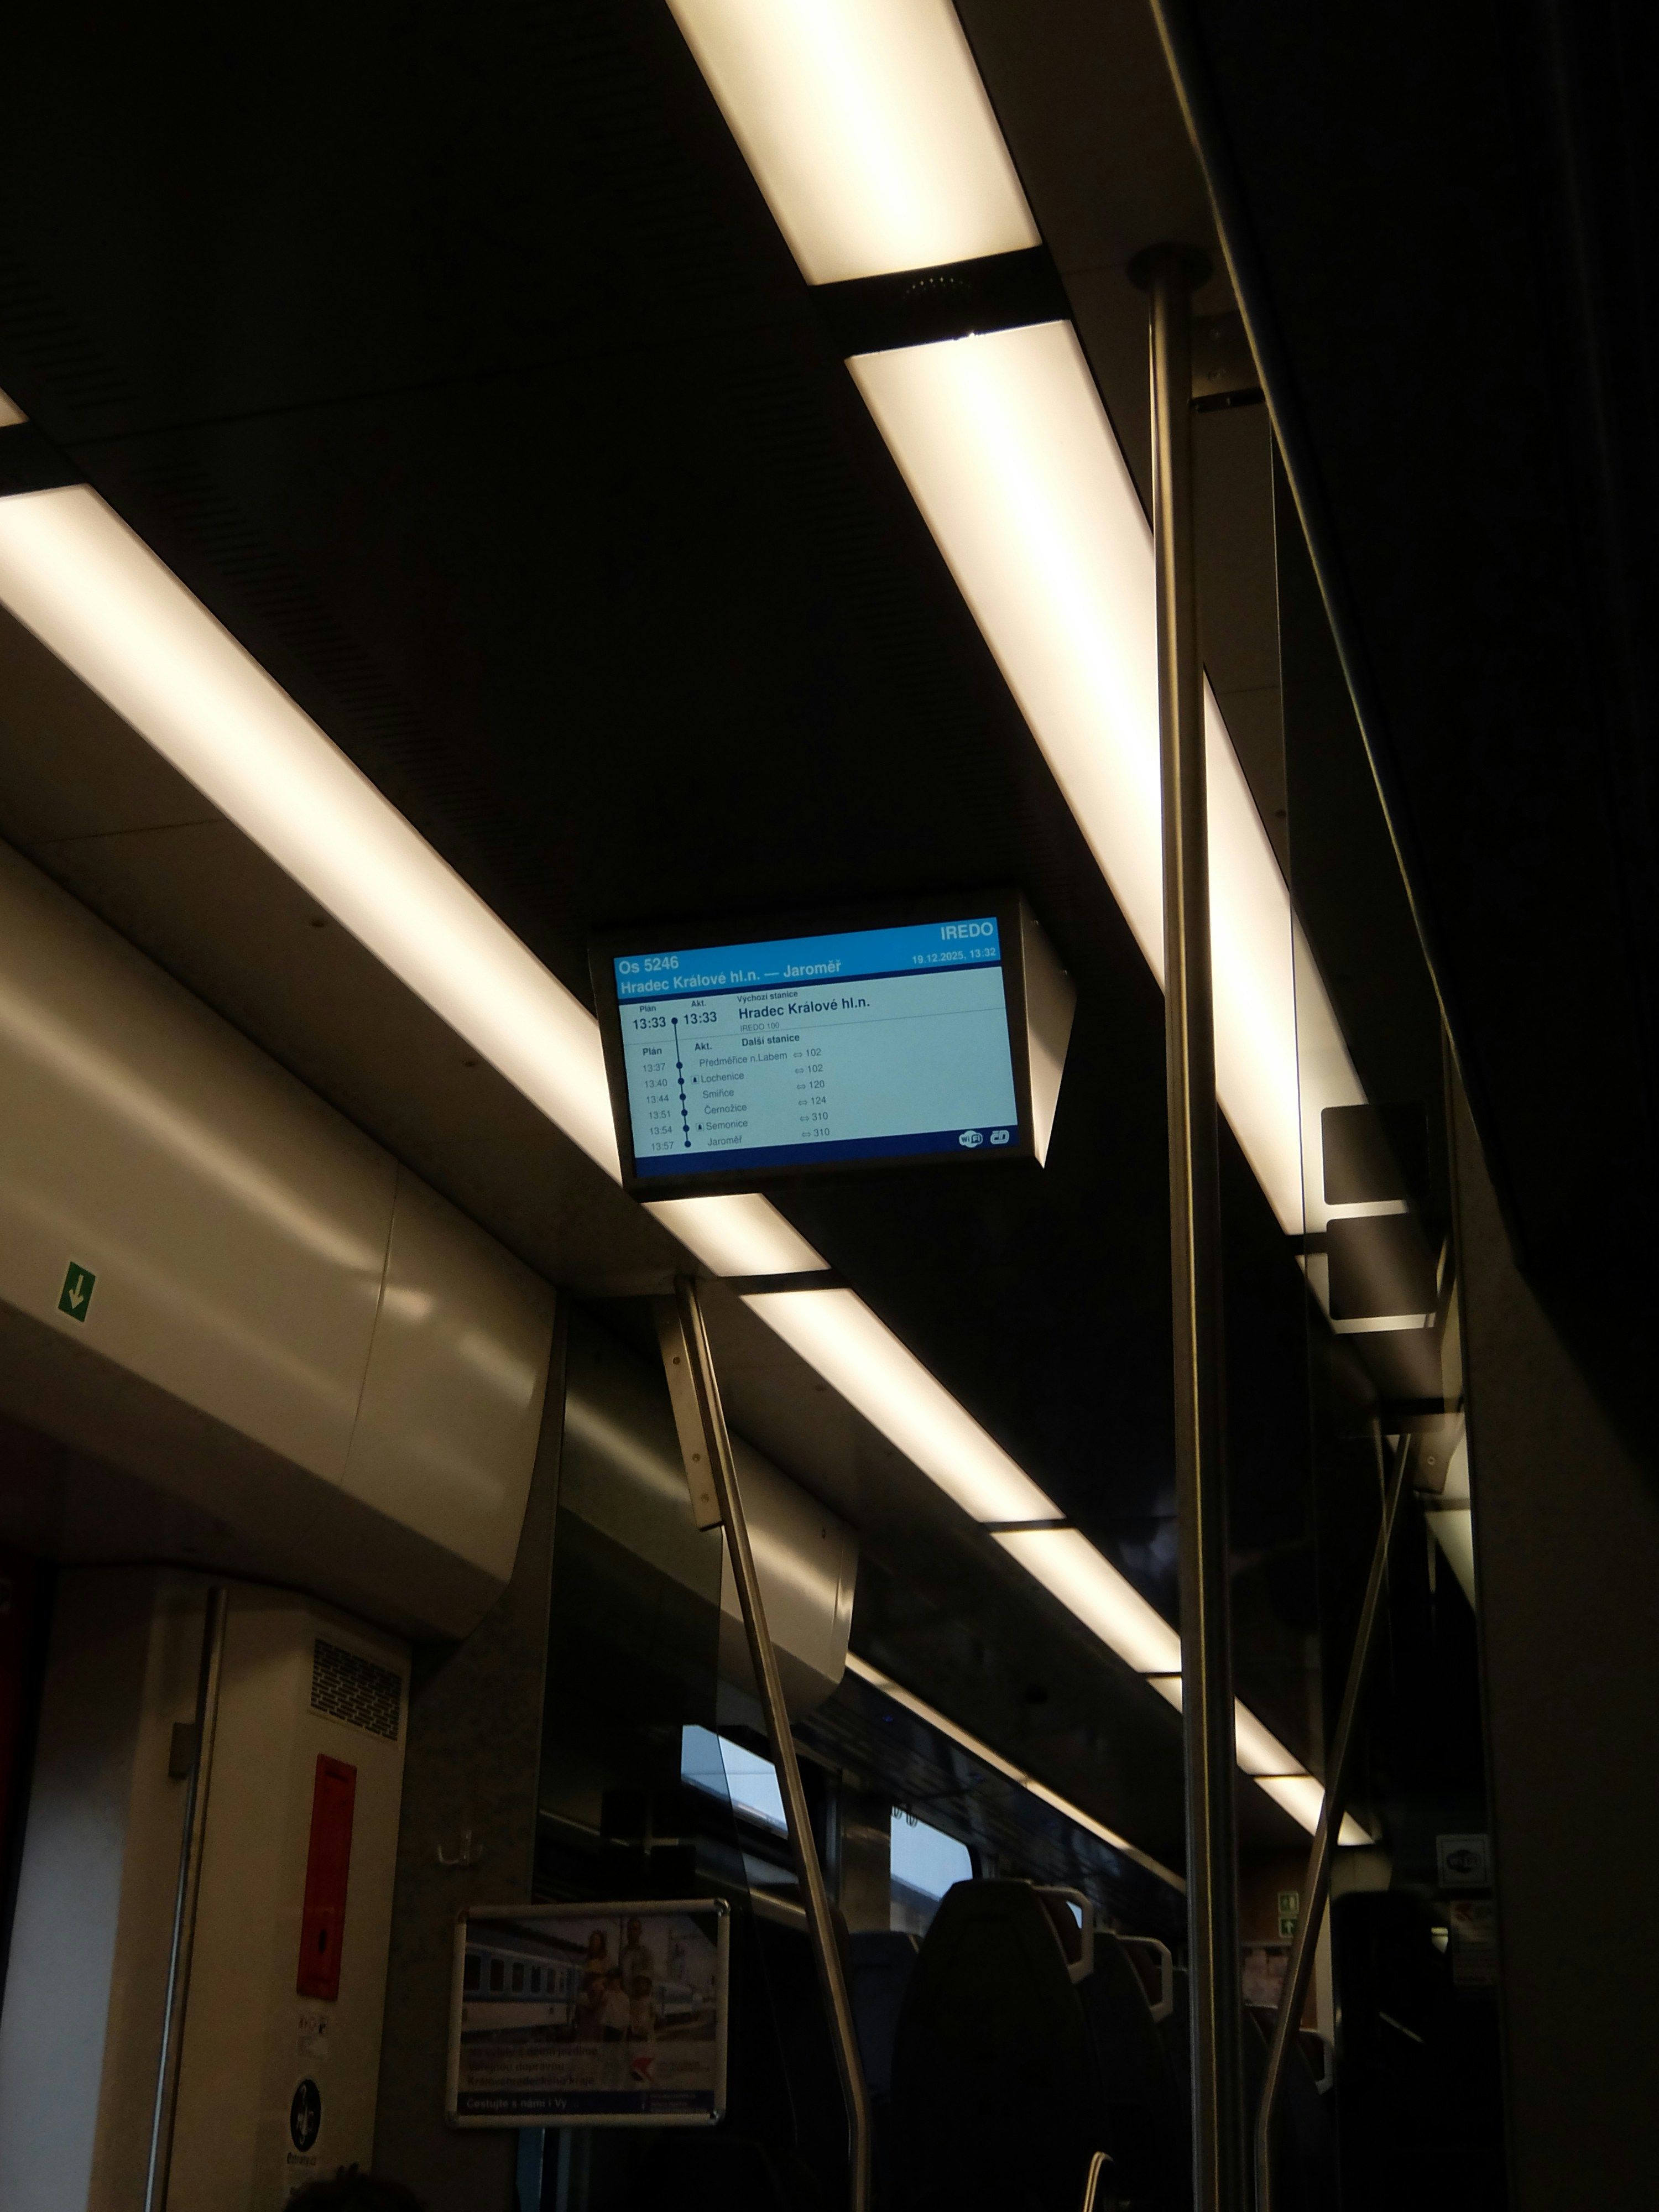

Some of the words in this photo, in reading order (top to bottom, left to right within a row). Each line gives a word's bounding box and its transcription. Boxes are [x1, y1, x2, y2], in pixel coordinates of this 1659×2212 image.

[941, 922, 994, 940] IREDO
[912, 951, 966, 964] 19.12.2025,
[970, 947, 996, 958] 13:32
[619, 961, 640, 974] Os
[644, 956, 679, 972] 5246
[621, 979, 669, 994] Hradec
[674, 972, 726, 989] Králové
[731, 970, 760, 983] hl.n.
[784, 959, 841, 977] Jaroměř
[691, 999, 706, 1008] Akt.
[737, 993, 768, 1004] Výchozí
[770, 991, 798, 1000] stanice
[639, 1004, 656, 1013] Plán
[739, 1006, 784, 1019] Hradec
[788, 1000, 838, 1015] Králové
[842, 997, 870, 1010] hl.n.
[633, 1016, 666, 1030] 13:33
[684, 1011, 717, 1025] 13:33
[740, 1023, 765, 1032] IREDO
[695, 1042, 712, 1051] Akt.
[742, 1036, 764, 1046] Další
[767, 1034, 800, 1044] stanice
[643, 1047, 662, 1056] Plán
[699, 1055, 748, 1067] Předměřice
[750, 1052, 787, 1063] n.Labem
[806, 1048, 822, 1057] 102
[643, 1063, 666, 1072] 13:37
[701, 1072, 744, 1083] Lochenice
[807, 1064, 823, 1073] 102
[644, 1078, 667, 1088] 13:40
[702, 1088, 734, 1099] Smiřice
[809, 1080, 825, 1089] 120
[646, 1094, 669, 1104] 13:44
[704, 1103, 747, 1115] Černožice
[811, 1096, 826, 1105] 124
[649, 1110, 671, 1119] 13:51
[706, 1119, 748, 1131] Semonice
[812, 1112, 828, 1121] 310
[650, 1126, 672, 1135] 13:54
[707, 1135, 742, 1146] Jaroměř
[813, 1128, 830, 1137] 310
[651, 1141, 674, 1151] 13:57
